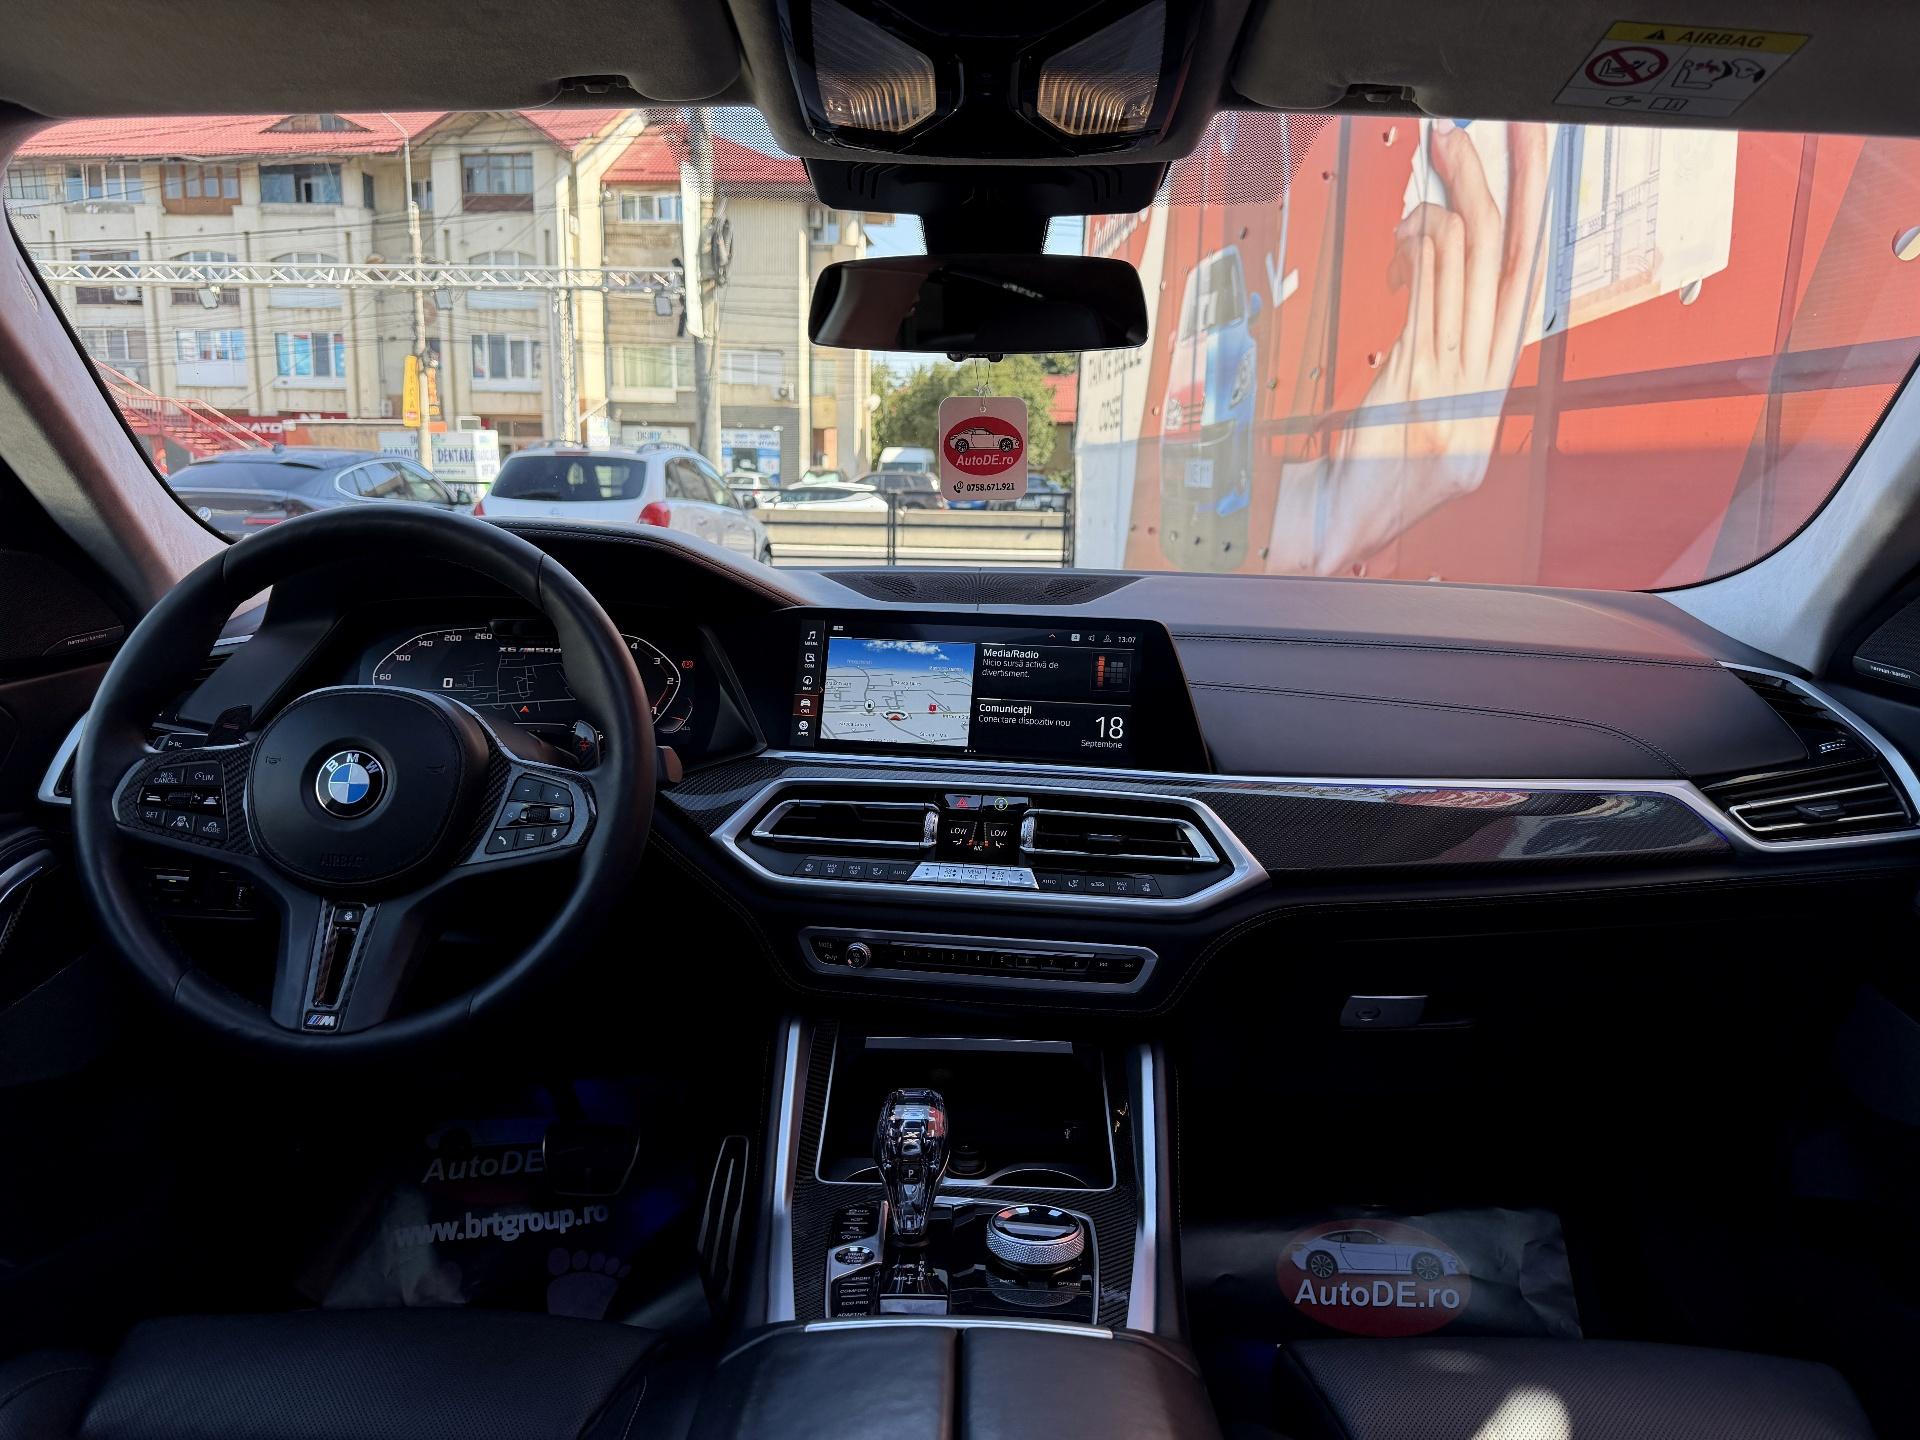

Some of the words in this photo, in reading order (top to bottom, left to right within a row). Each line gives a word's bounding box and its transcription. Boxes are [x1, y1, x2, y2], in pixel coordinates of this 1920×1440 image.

[1676, 31, 1766, 49] AIRBAG
[956, 454, 1014, 466] AutoDE.ro
[966, 482, 1016, 492] 0758.671.921
[444, 634, 462, 642] 200
[474, 633, 493, 641] 260
[630, 642, 638, 650] 4
[396, 654, 411, 662] 100
[983, 649, 1039, 659] Media/Radio
[653, 657, 661, 665] 3
[982, 659, 1001, 667] Nicio
[1048, 660, 1059, 669] de
[379, 673, 392, 681] 60
[666, 677, 674, 685] 2
[443, 677, 453, 688] 0
[651, 706, 658, 715] 1
[978, 714, 1017, 724] Conectare
[1018, 716, 1055, 727] dispozitiv
[1055, 718, 1071, 727] nou
[1095, 716, 1124, 740] 18
[1080, 739, 1123, 749] Septembrie
[326, 752, 379, 775] BMW
[950, 827, 967, 835] LOW
[990, 829, 1008, 837] LOW
[908, 1169, 914, 1178] P
[1294, 1279, 1460, 1309] AutoDE.ro
